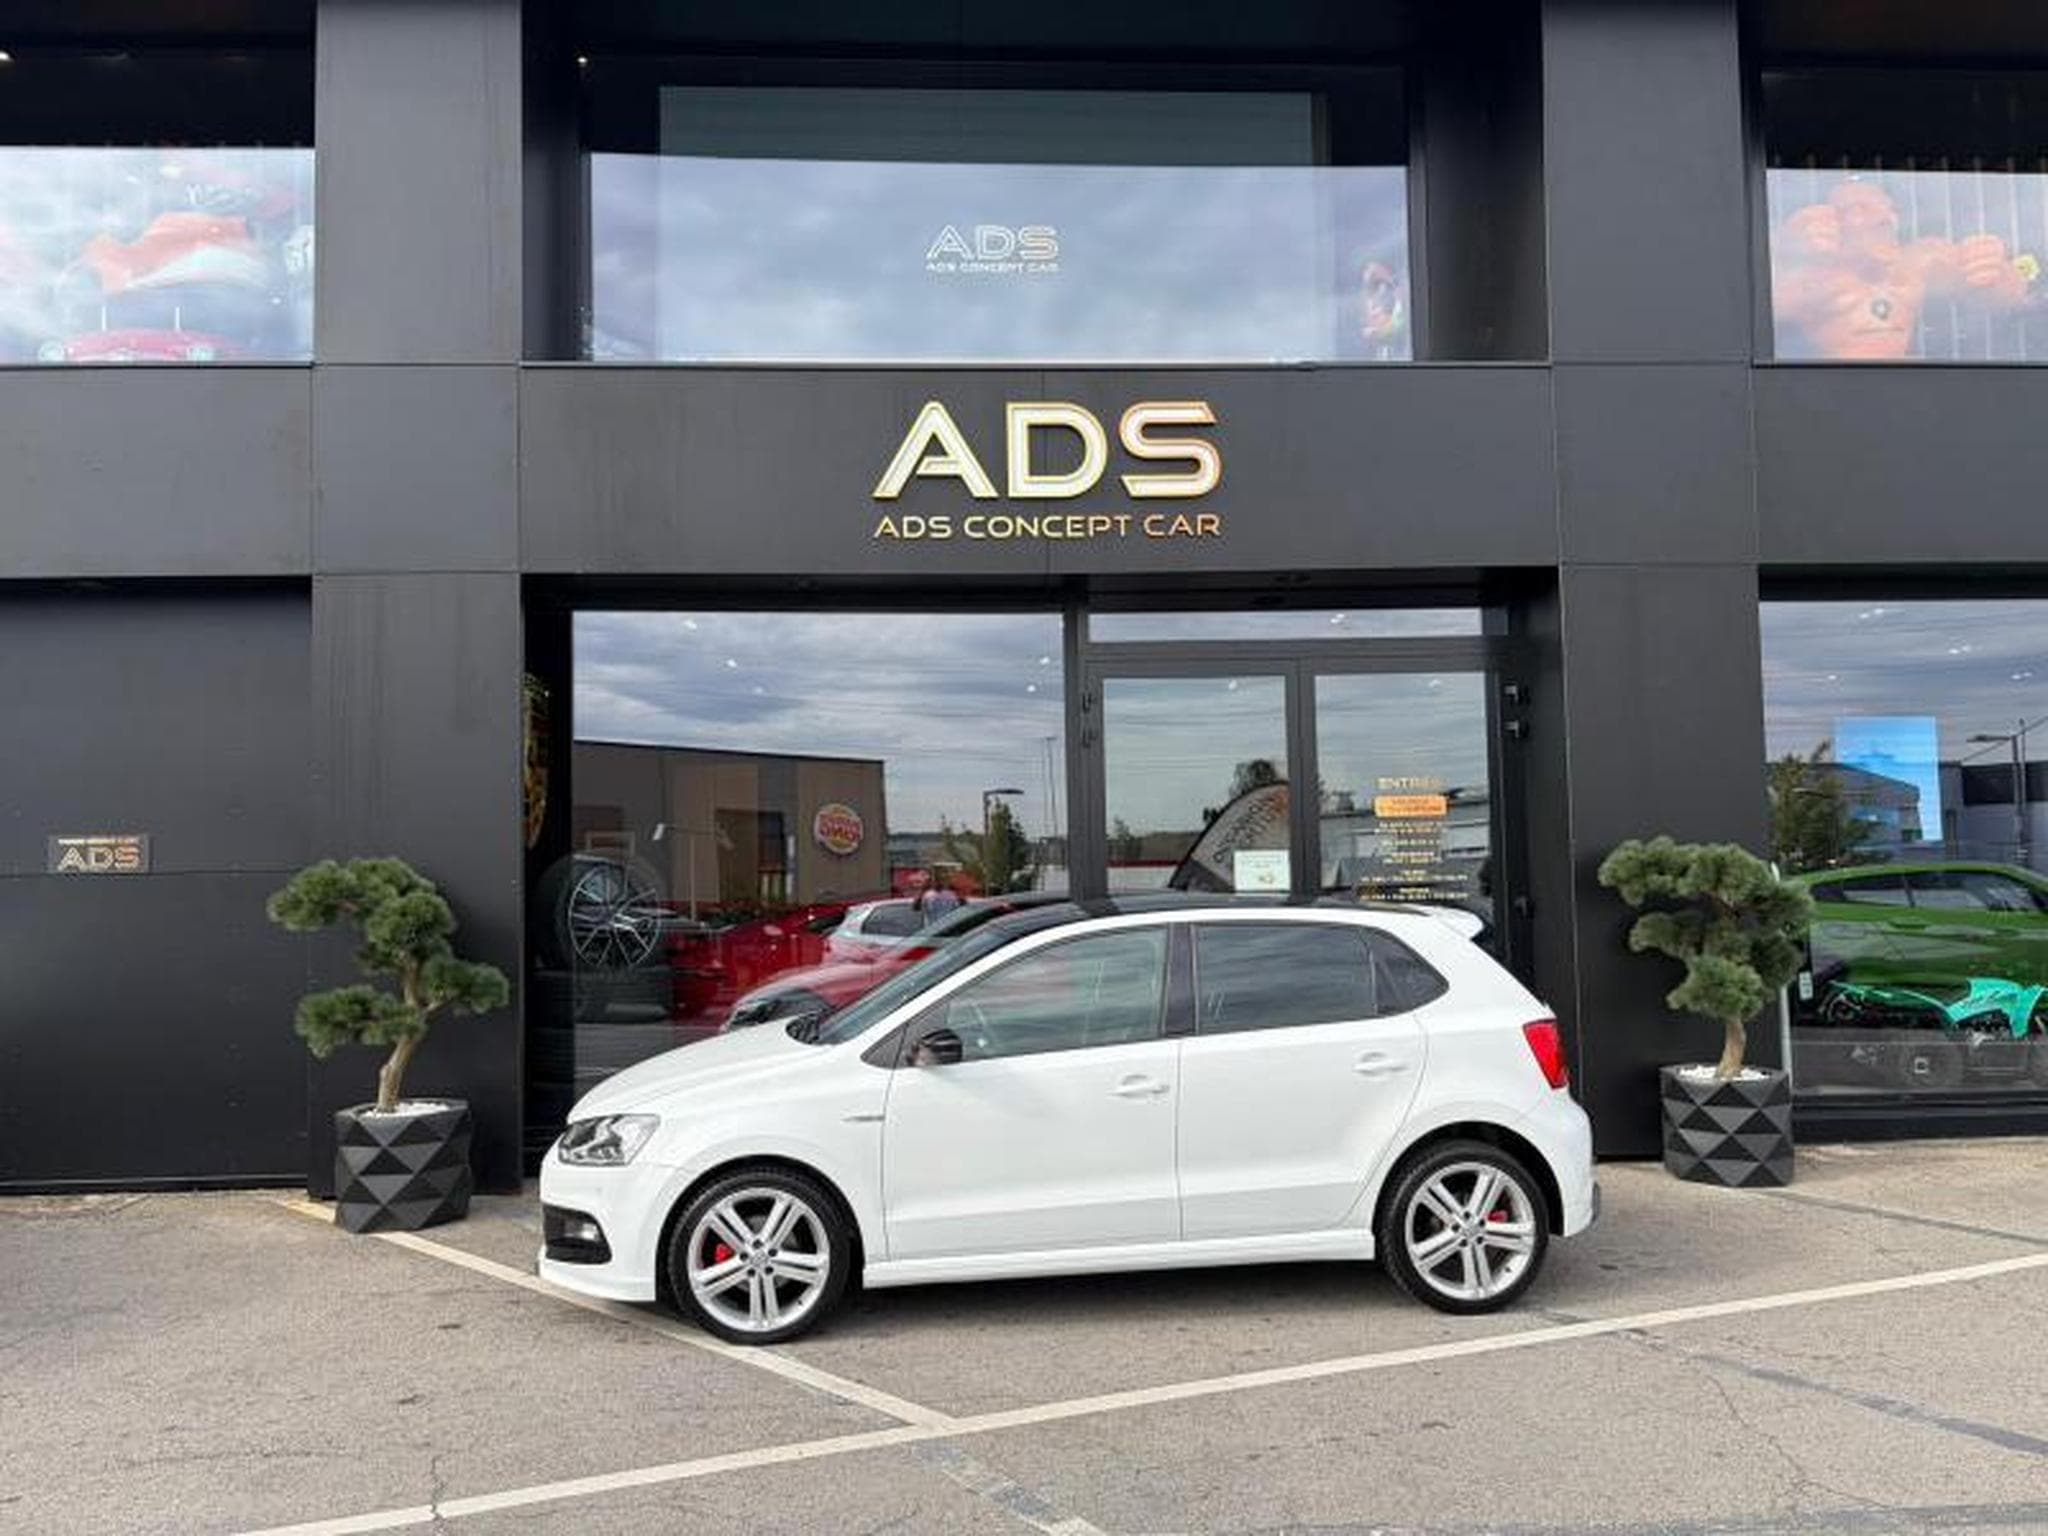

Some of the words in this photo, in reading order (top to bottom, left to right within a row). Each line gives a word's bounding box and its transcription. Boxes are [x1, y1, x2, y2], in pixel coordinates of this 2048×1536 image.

[926, 225, 1060, 260] ADS
[872, 401, 1222, 498] ADS
[873, 515, 951, 539] ADS
[963, 515, 1132, 539] CONCEPT
[1143, 513, 1222, 538] CAR
[58, 847, 140, 871] ADS
